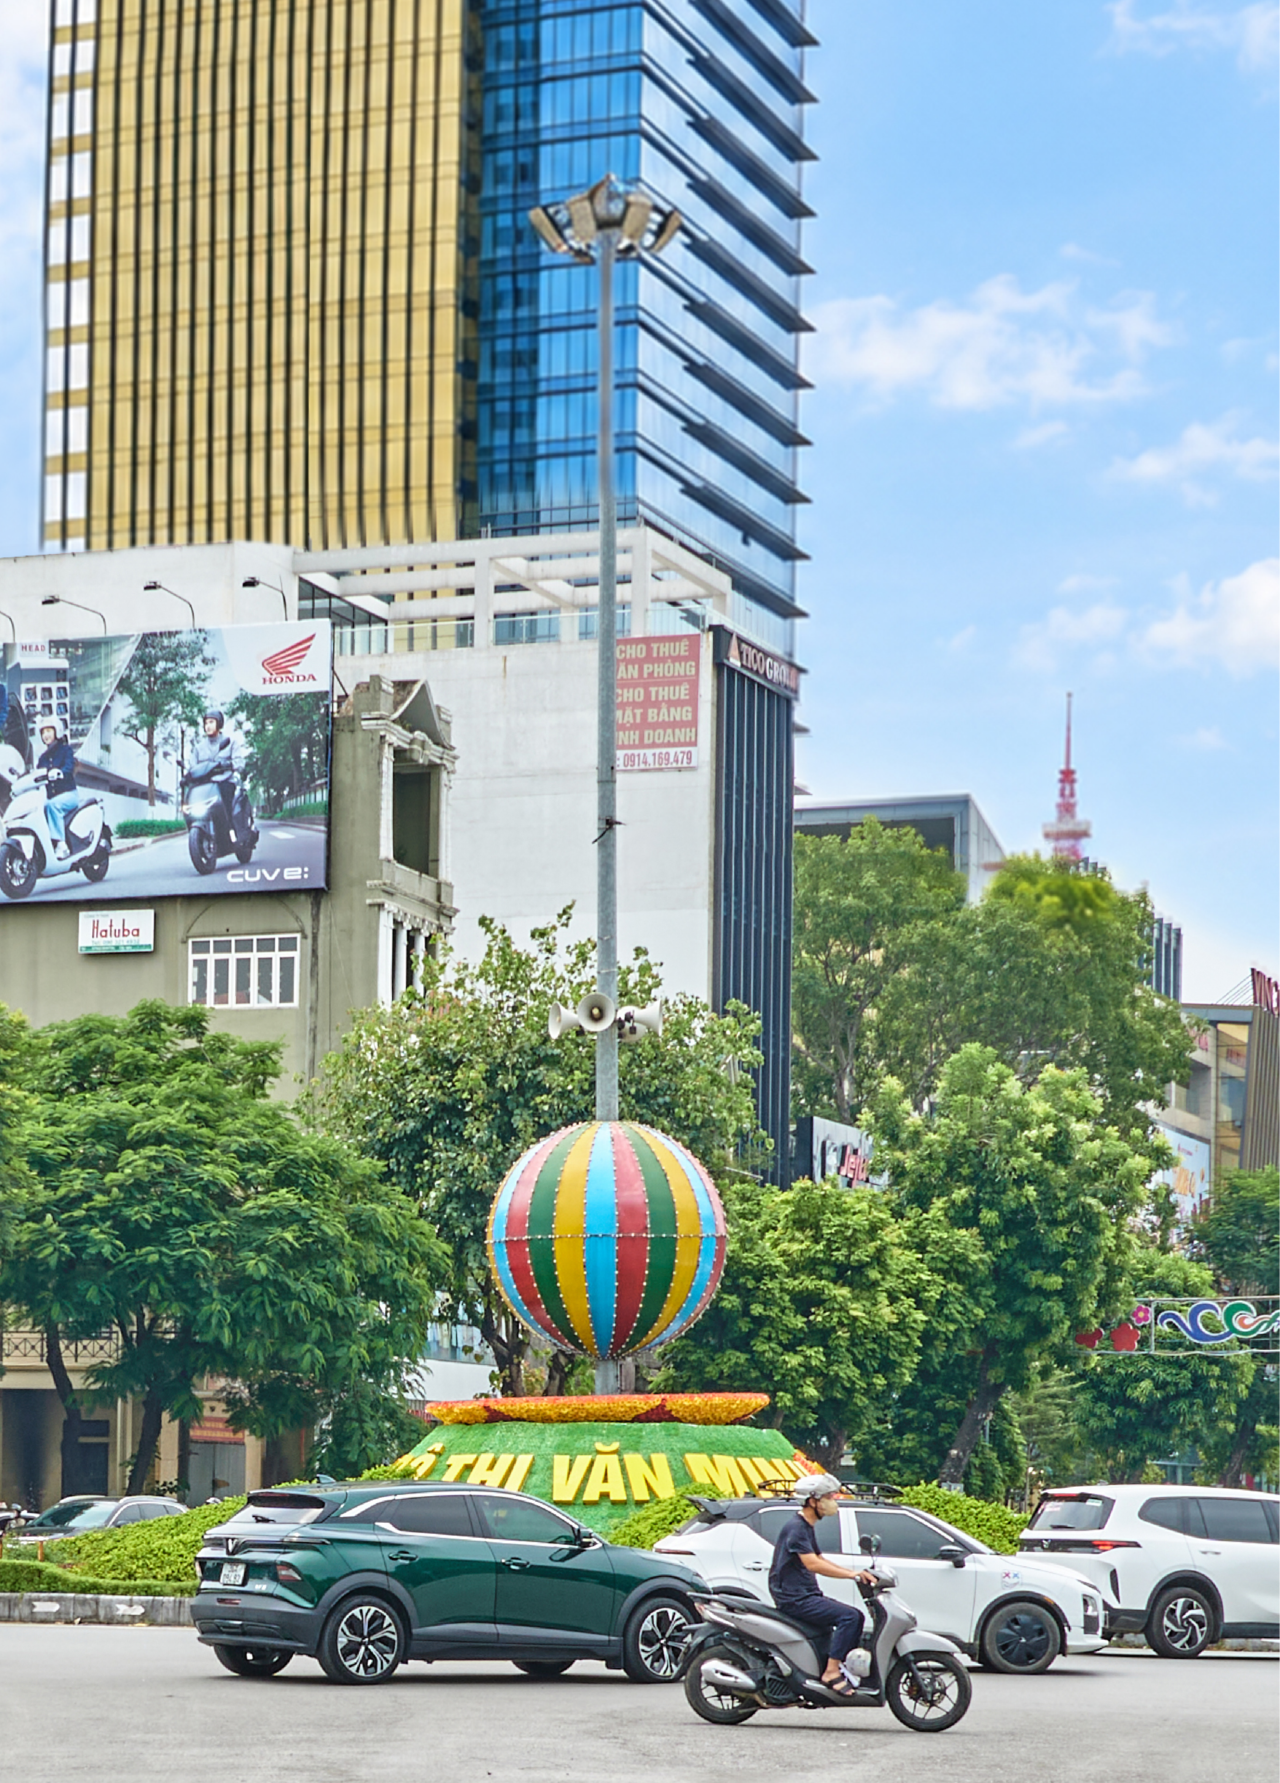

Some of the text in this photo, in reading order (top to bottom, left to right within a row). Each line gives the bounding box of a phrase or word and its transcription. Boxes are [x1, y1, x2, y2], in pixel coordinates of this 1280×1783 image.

[21, 645, 45, 653] HEAD
[616, 638, 689, 659] CHO THUÊ
[262, 673, 317, 685] HONDA
[616, 659, 696, 679] ĂN PHÒNG
[766, 657, 798, 692] GRO
[649, 682, 690, 701] THUÊ
[644, 728, 696, 745] DOANH
[92, 918, 140, 938] Hatuba
[552, 1441, 676, 1505] VĂN
